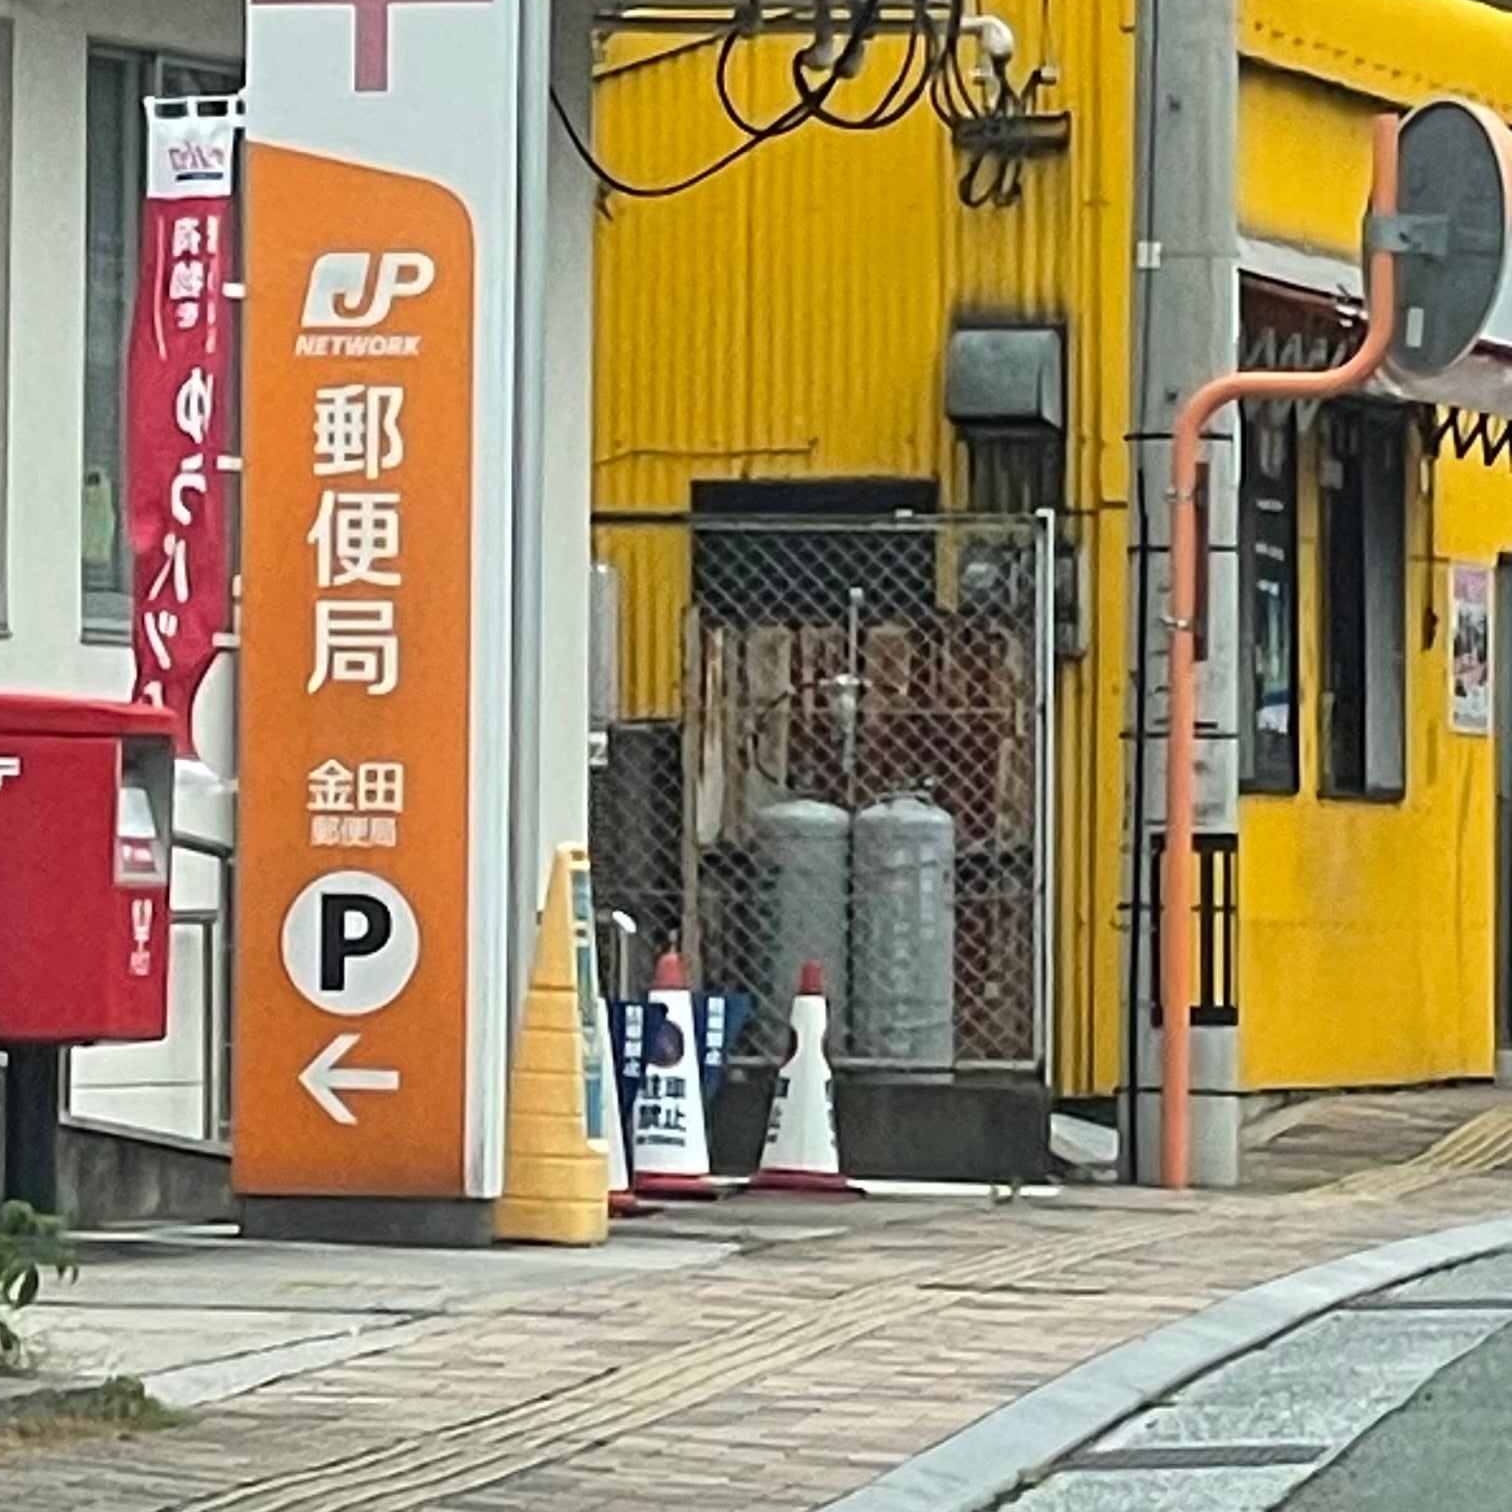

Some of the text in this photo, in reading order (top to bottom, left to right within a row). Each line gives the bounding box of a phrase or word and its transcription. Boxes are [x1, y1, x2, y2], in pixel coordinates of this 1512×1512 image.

[300, 252, 436, 328] JP
[295, 335, 421, 357] NETWORK
[307, 383, 405, 696] 郵便局
[306, 758, 405, 814] 金田
[310, 815, 397, 847] 郵便局
[319, 892, 392, 992] P
